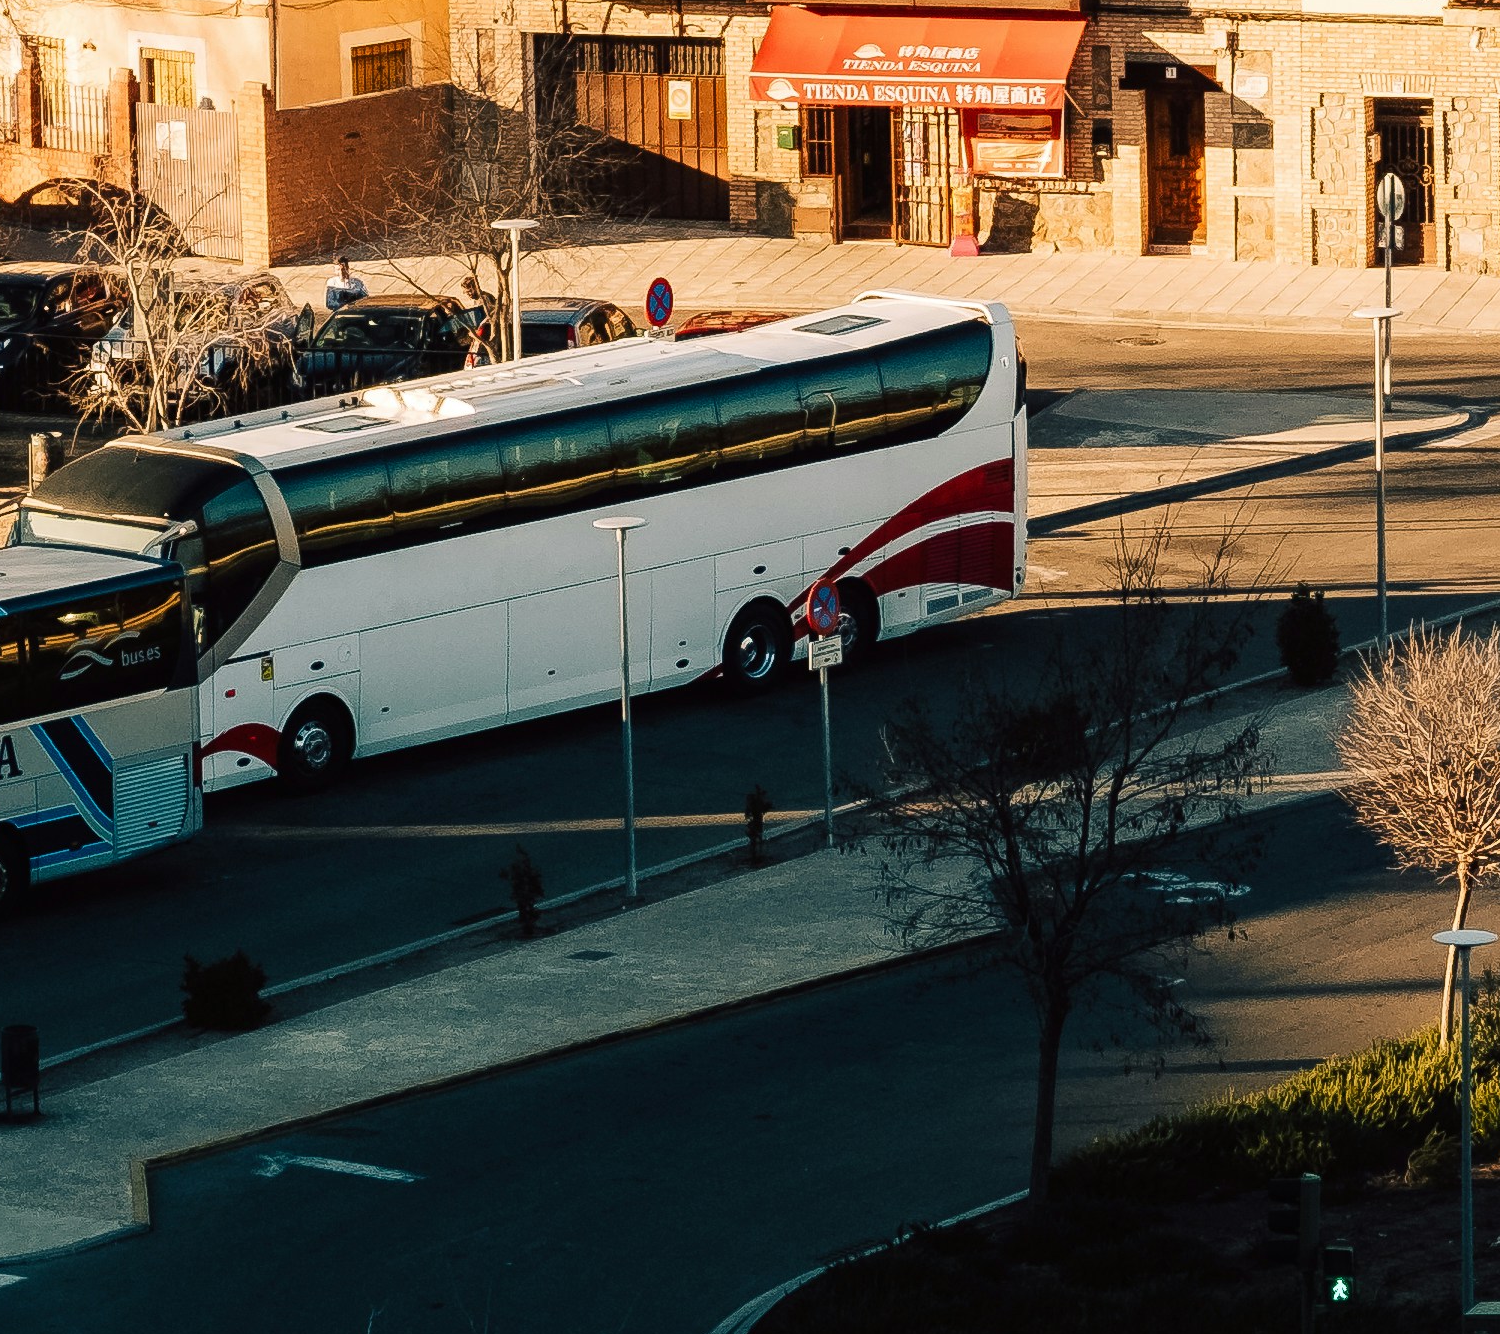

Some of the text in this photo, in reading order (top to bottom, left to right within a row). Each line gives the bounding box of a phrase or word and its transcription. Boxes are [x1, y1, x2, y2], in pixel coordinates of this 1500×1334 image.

[841, 59, 981, 74] TIENDA ESQUINA
[803, 83, 869, 101] TIENDA
[873, 84, 951, 104] ESQUINA
[121, 645, 161, 667] bus.es
